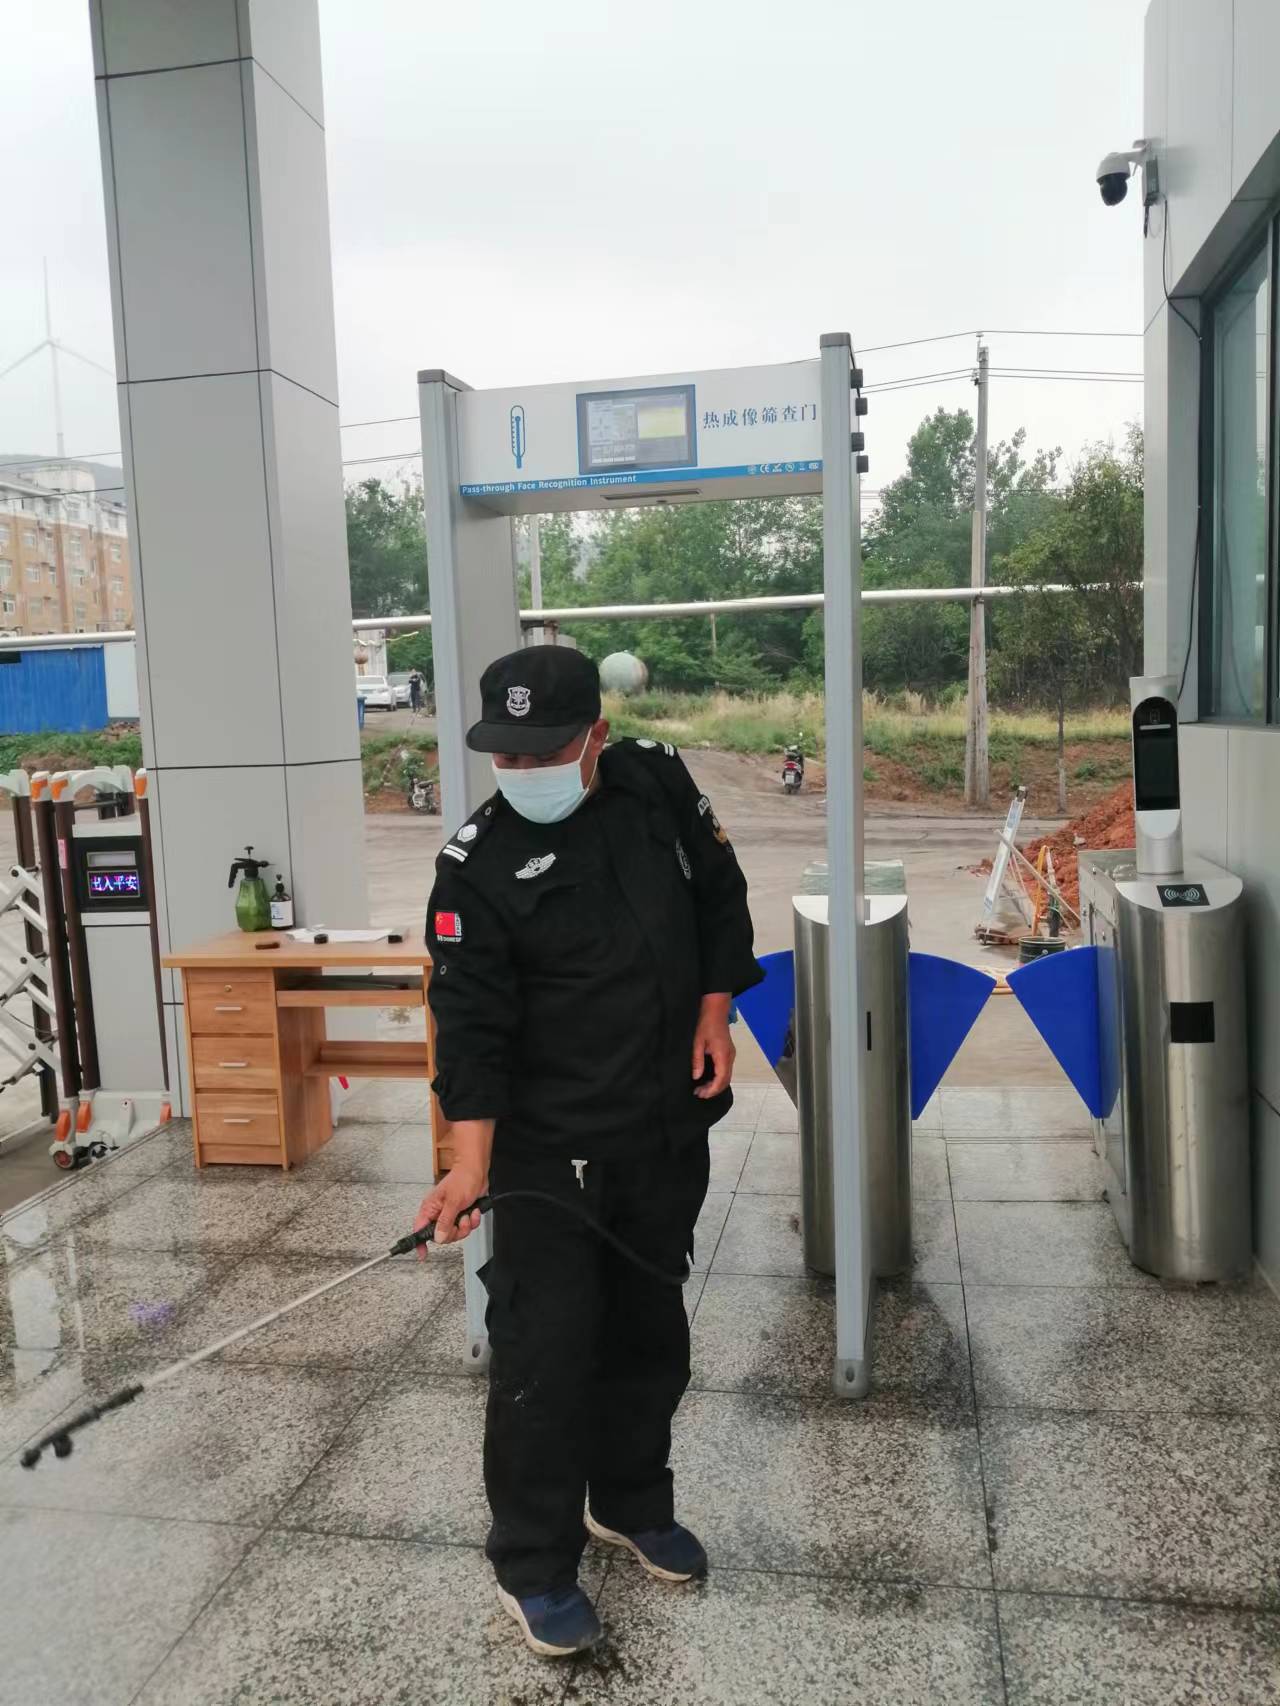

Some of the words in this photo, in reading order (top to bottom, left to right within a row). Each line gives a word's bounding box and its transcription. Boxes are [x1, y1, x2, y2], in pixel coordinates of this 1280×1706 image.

[703, 404, 816, 429] 热成像筛查门
[462, 483, 515, 494] Pass-through
[518, 481, 536, 490] Face
[539, 479, 588, 490] Recognition
[590, 475, 637, 485] Instrument
[91, 875, 137, 891] 出入平安
